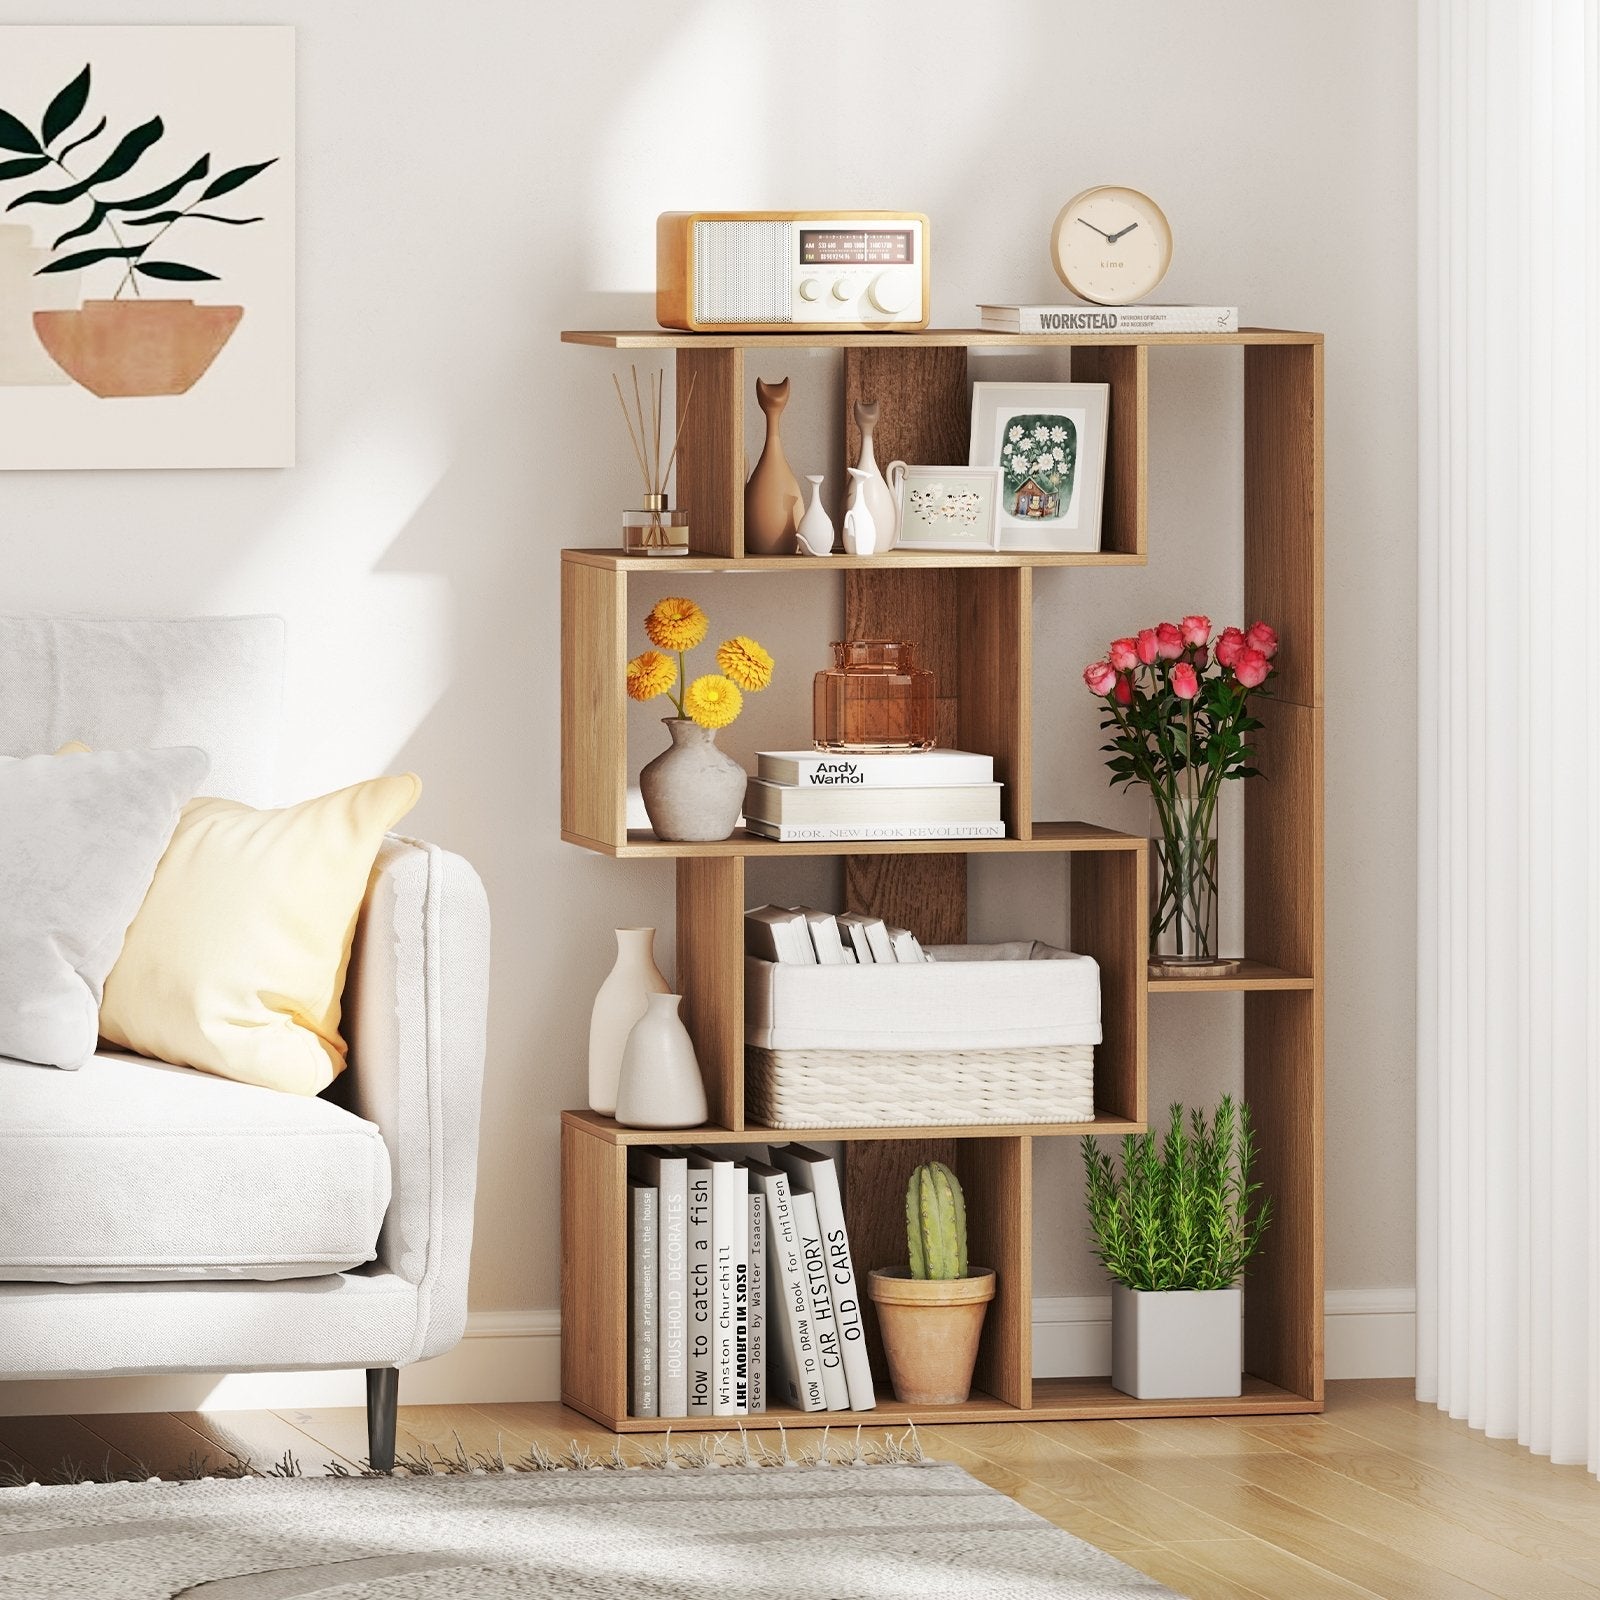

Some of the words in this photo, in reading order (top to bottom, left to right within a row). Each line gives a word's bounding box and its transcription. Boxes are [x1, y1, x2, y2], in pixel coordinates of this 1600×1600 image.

[1039, 313, 1118, 329] WORKSTEAD
[809, 773, 864, 785] Warhol
[816, 762, 857, 775] Andy
[829, 829, 860, 838] NEW
[865, 828, 904, 838] LOOK
[908, 826, 999, 837] REVOLUTION
[643, 1192, 651, 1221] house
[690, 1179, 708, 1226] fish
[775, 1180, 793, 1243] children
[643, 1225, 651, 1242] the
[668, 1193, 682, 1281] DECORATES
[751, 1196, 761, 1255] Isaacson
[642, 1247, 651, 1260] in
[695, 1239, 708, 1250] a
[827, 1229, 852, 1285] CARS
[787, 1251, 798, 1274] for
[690, 1263, 708, 1322] catch
[719, 1245, 730, 1329] Churchill
[751, 1263, 761, 1307] Walter
[802, 1237, 832, 1321] HISTORY
[643, 1264, 653, 1326] arrangement
[791, 1281, 805, 1313] Book
[668, 1290, 682, 1378] HOUSEHOLD
[751, 1313, 763, 1328] by
[840, 1299, 861, 1341] OLD
[644, 1330, 651, 1343] an
[692, 1335, 708, 1358] to
[751, 1335, 761, 1364] Jobs
[797, 1320, 812, 1352] DRAW
[819, 1331, 840, 1368] CAR
[643, 1347, 651, 1371] make
[719, 1338, 730, 1405] Winston
[804, 1358, 816, 1375] TO
[643, 1375, 651, 1386] to
[691, 1370, 708, 1406] How
[751, 1372, 761, 1409] Steve
[808, 1381, 821, 1406] HOW
[643, 1391, 651, 1409] How
